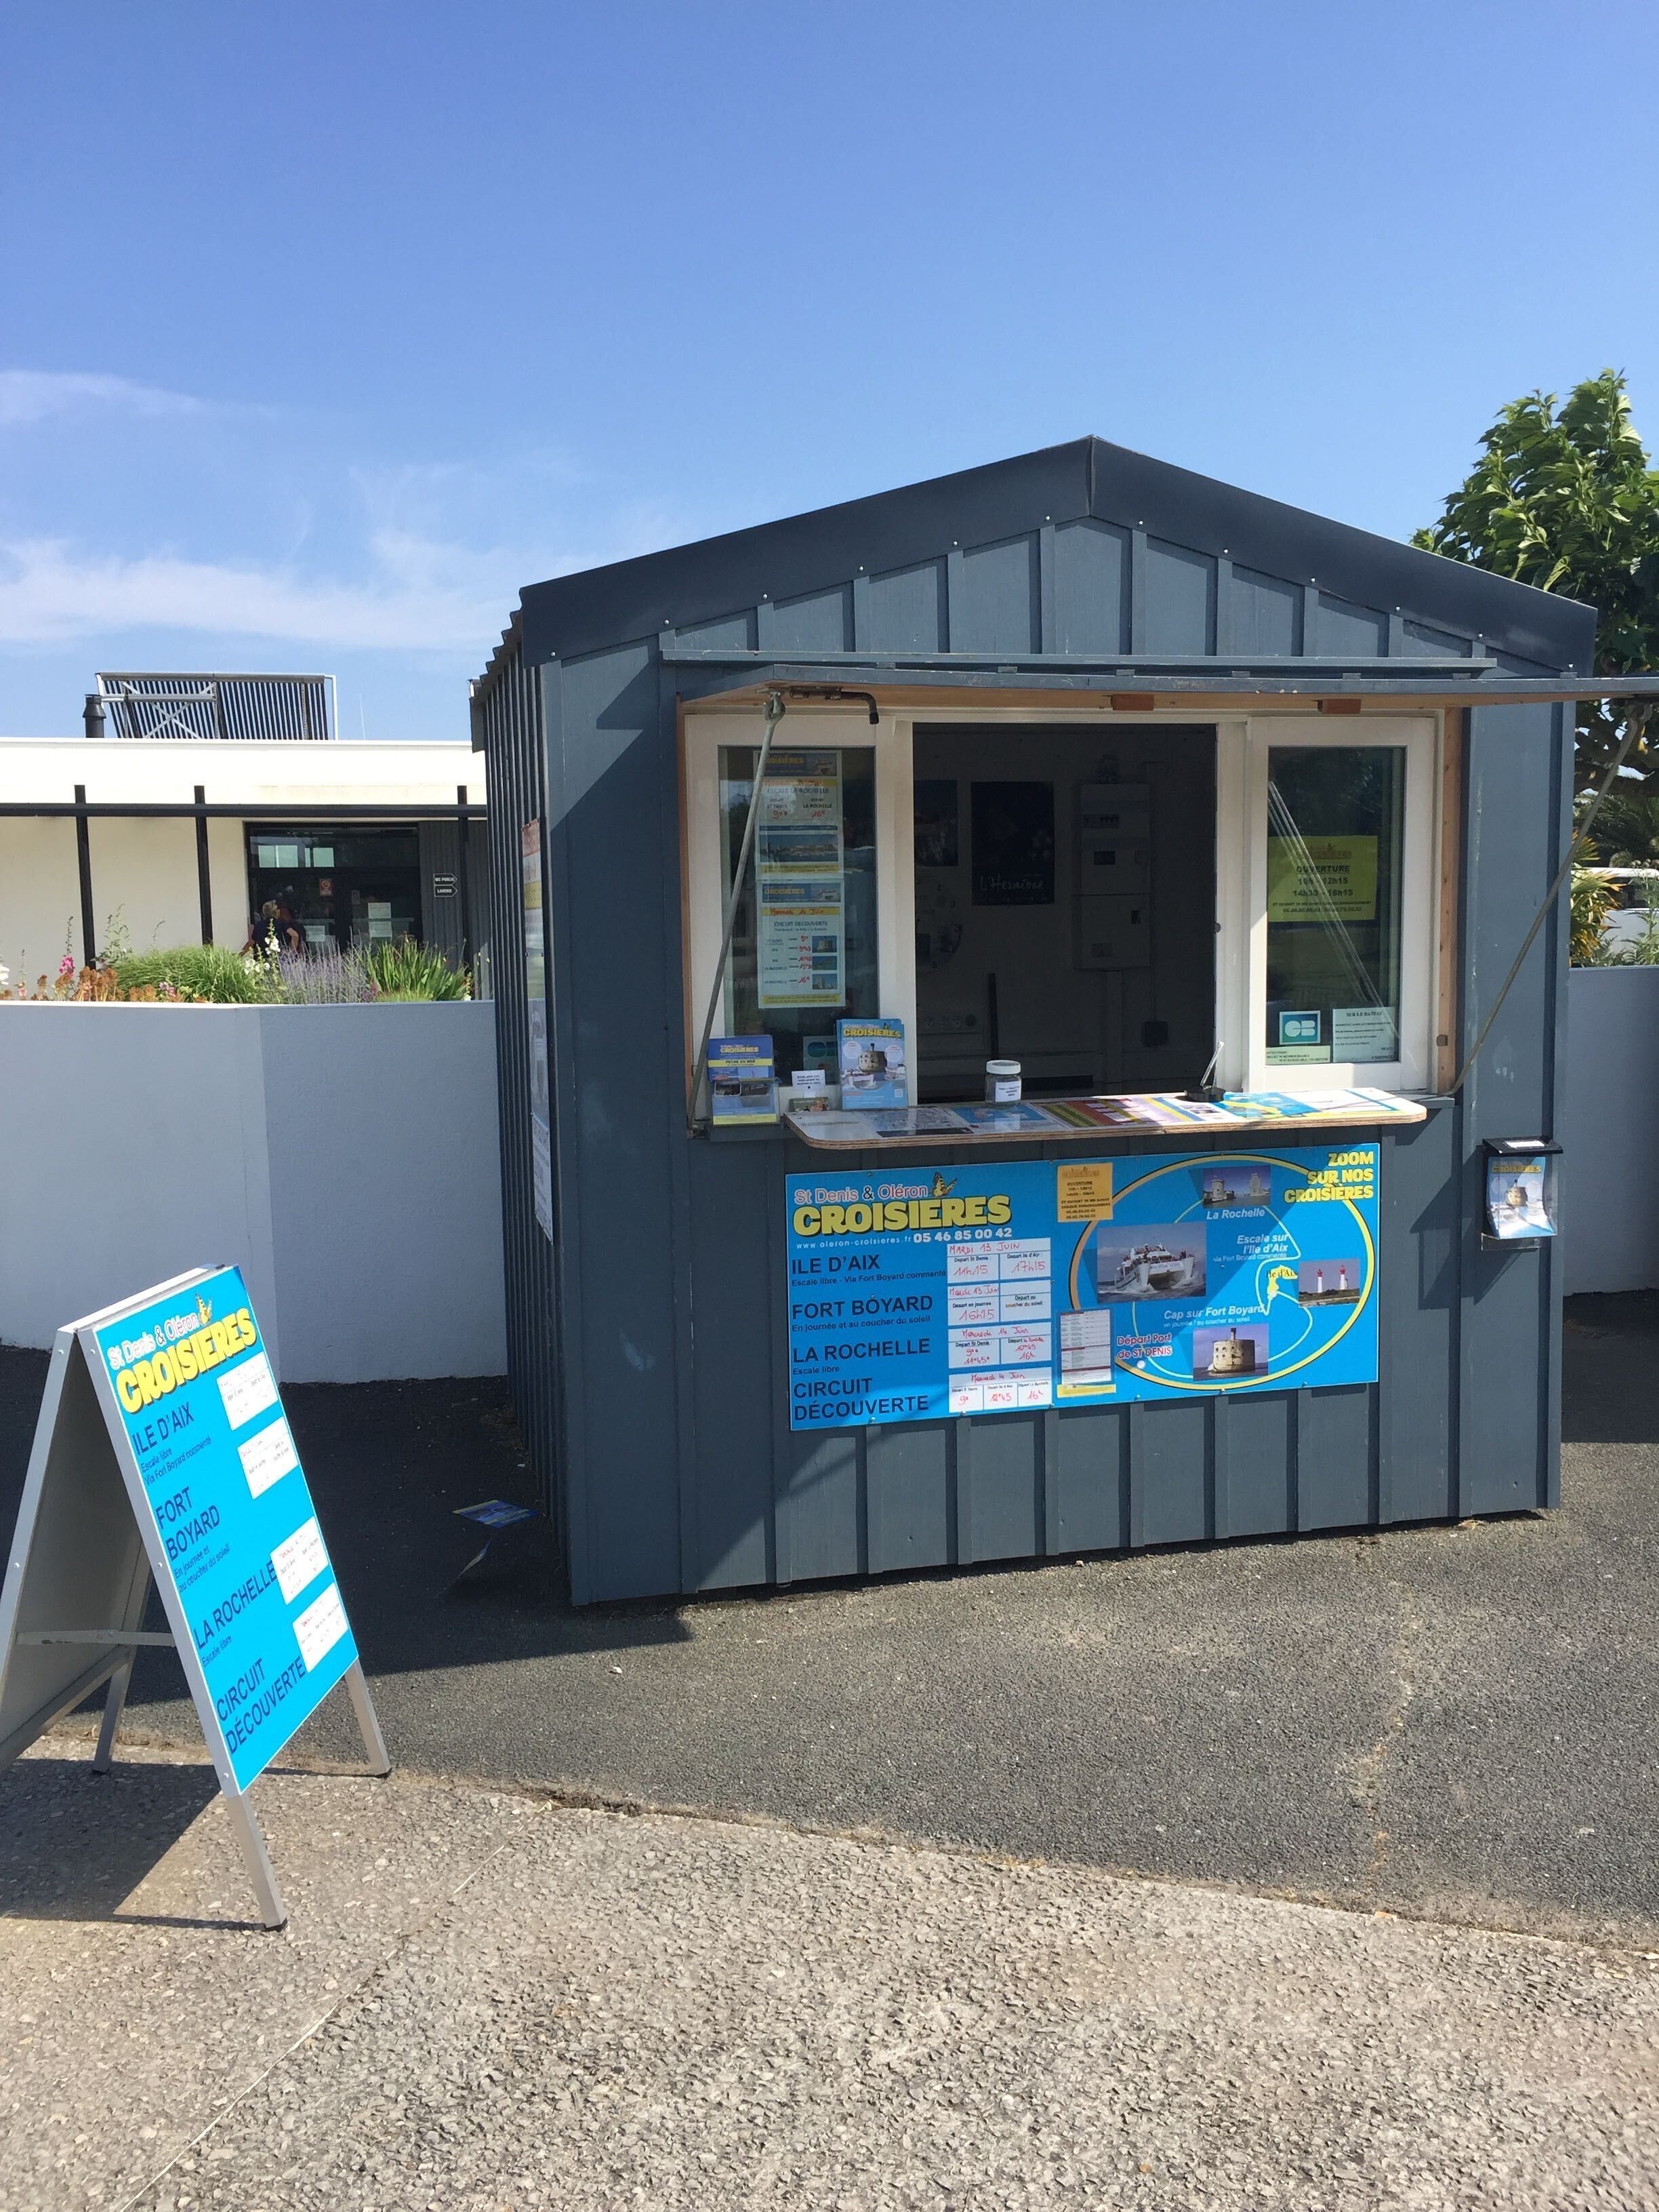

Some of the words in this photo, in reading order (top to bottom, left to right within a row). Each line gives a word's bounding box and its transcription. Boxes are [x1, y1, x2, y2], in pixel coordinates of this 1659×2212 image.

[1328, 1151, 1374, 1166] ZOOM
[1307, 1170, 1339, 1185] SUR
[1342, 1168, 1374, 1183] NOS
[794, 1189, 811, 1204] St
[815, 1187, 859, 1203] Denis
[863, 1186, 873, 1199] &
[878, 1183, 928, 1199] Oléron
[793, 1195, 1012, 1237] CROISIERES
[1206, 1211, 1218, 1220] La
[1221, 1208, 1265, 1218] Rochelle
[914, 1233, 930, 1243] 05
[935, 1231, 951, 1242] 46
[954, 1231, 971, 1240] 85
[975, 1230, 991, 1239] 00
[995, 1228, 1012, 1237] 42
[1237, 1235, 1269, 1244] Escale
[1271, 1234, 1288, 1242] sur
[950, 1245, 973, 1254] MARDI
[980, 1244, 991, 1252] 13
[997, 1242, 1019, 1251] JUIN
[792, 1258, 821, 1275] ILE
[829, 1254, 880, 1272] D'AIX
[954, 1265, 988, 1276] 11h15
[1011, 1261, 1045, 1273] 17h15
[792, 1278, 817, 1286] Escale
[877, 1273, 904, 1282] Boyard
[792, 1301, 845, 1319] FORT
[852, 1295, 933, 1315] BOYARD
[959, 1309, 994, 1321] 16h15
[1164, 1311, 1183, 1321] Cap
[1206, 1307, 1226, 1317] Fort
[1229, 1305, 1265, 1316] Boyard
[805, 1323, 836, 1332] journée
[861, 1319, 893, 1327] coucher
[107, 1345, 125, 1370] St
[121, 1333, 156, 1365] Denis
[155, 1326, 165, 1346] &
[164, 1311, 201, 1340] Oléron
[794, 1347, 819, 1363] LA
[825, 1338, 930, 1361] ROCHELLE
[1117, 1334, 1150, 1347] Départ
[1153, 1333, 1171, 1342] Port
[116, 1308, 257, 1414] CROISIERES
[1118, 1349, 1131, 1359] de
[1132, 1349, 1143, 1357] ST
[1145, 1346, 1172, 1356] DENIS
[793, 1367, 819, 1375] Escale
[794, 1378, 873, 1398] CIRCUIT
[794, 1395, 928, 1420] DÉCOUVERTE
[132, 1424, 157, 1456] ILE
[157, 1401, 194, 1441] D'AIX
[141, 1456, 160, 1473] Escale
[160, 1448, 173, 1460] libre
[145, 1474, 155, 1486] Via
[155, 1465, 167, 1479] Fort
[166, 1452, 186, 1471] Boyard
[155, 1486, 192, 1530] FORT
[165, 1505, 220, 1561] BOYARD
[173, 1568, 183, 1579] En
[178, 1585, 187, 1593] au
[187, 1564, 208, 1586] coucher
[209, 1558, 216, 1568] du
[216, 1543, 230, 1561] soleil
[194, 1619, 215, 1650] LA
[213, 1561, 278, 1633] ROCHELLE
[201, 1644, 220, 1668] Escale
[220, 1635, 232, 1652] libre
[217, 1658, 265, 1722] CIRCUIT
[225, 1656, 306, 1755] DÉCOUVERTE
